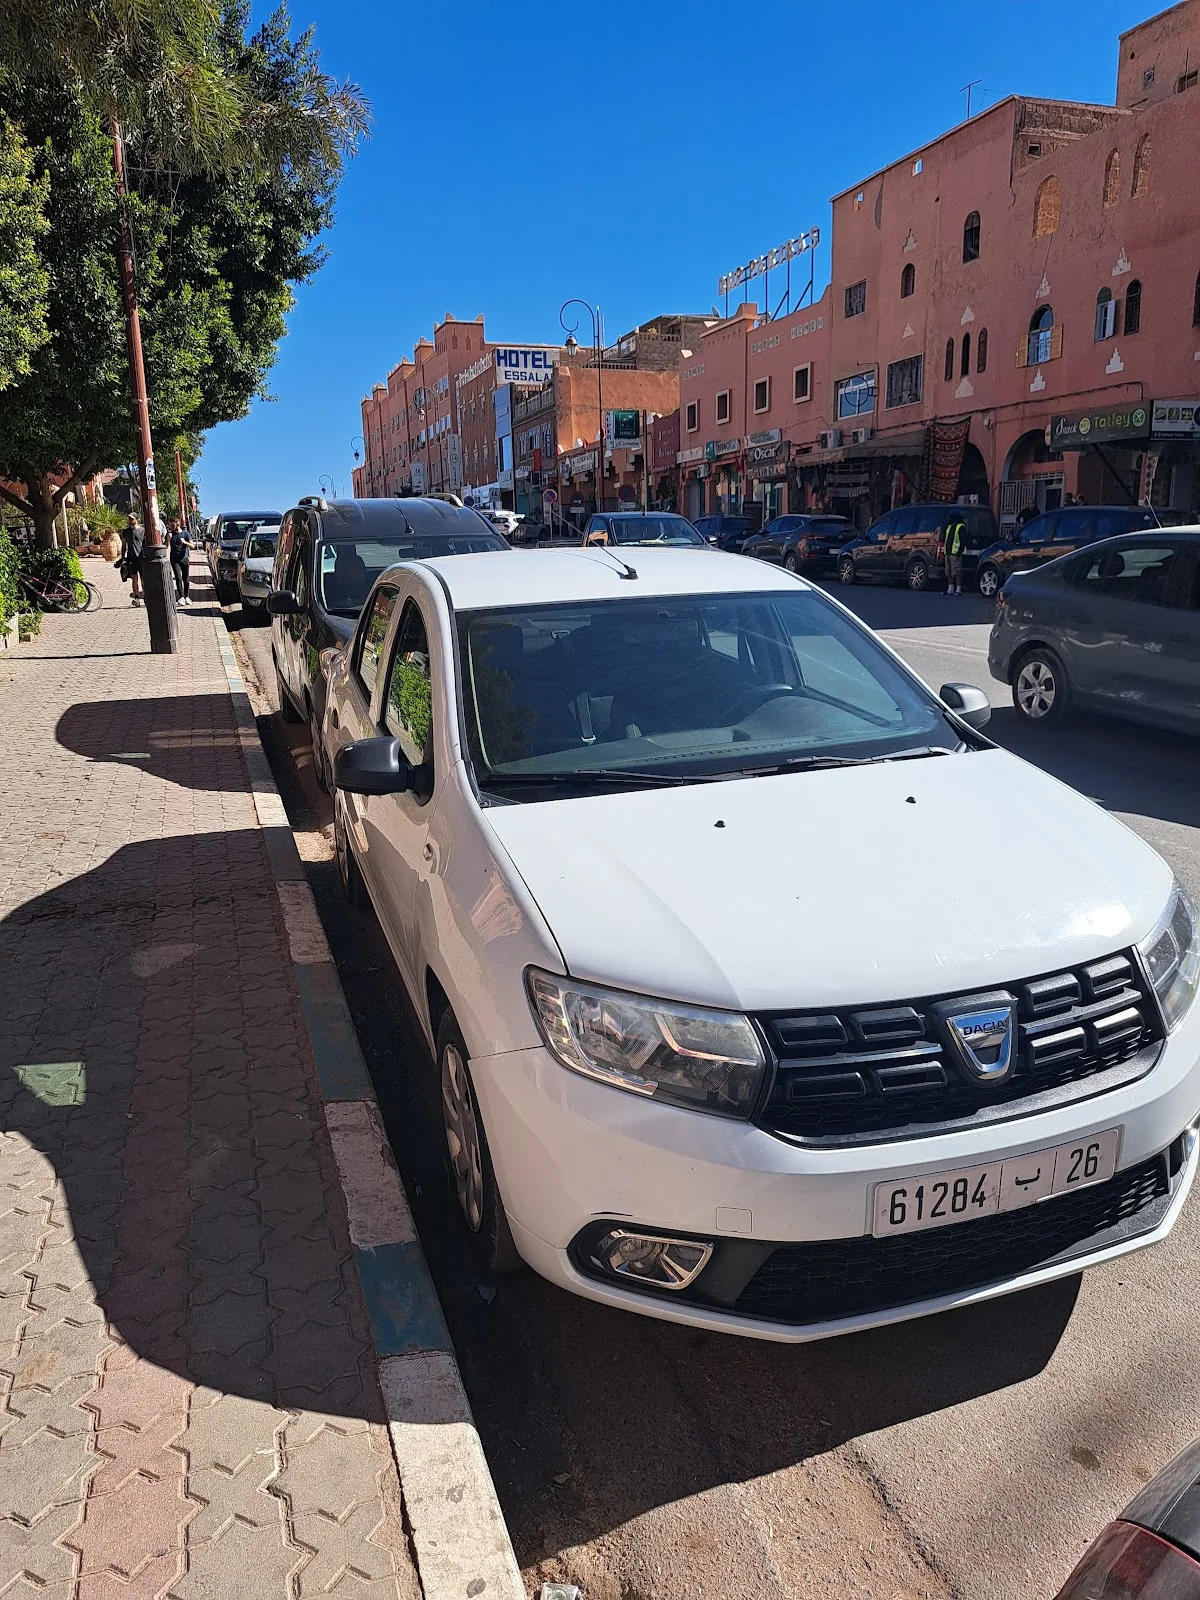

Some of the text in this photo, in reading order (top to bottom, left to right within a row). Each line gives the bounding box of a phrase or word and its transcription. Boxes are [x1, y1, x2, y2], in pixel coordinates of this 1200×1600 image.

[748, 226, 820, 279] PARIBAS
[496, 348, 553, 369] HOTEL
[504, 370, 552, 382] ESSALA
[1093, 413, 1131, 429] Tatfey
[754, 447, 775, 460] Oscar
[963, 1020, 1006, 1036] DACIA
[889, 1142, 1100, 1225] 61284 ب 26
